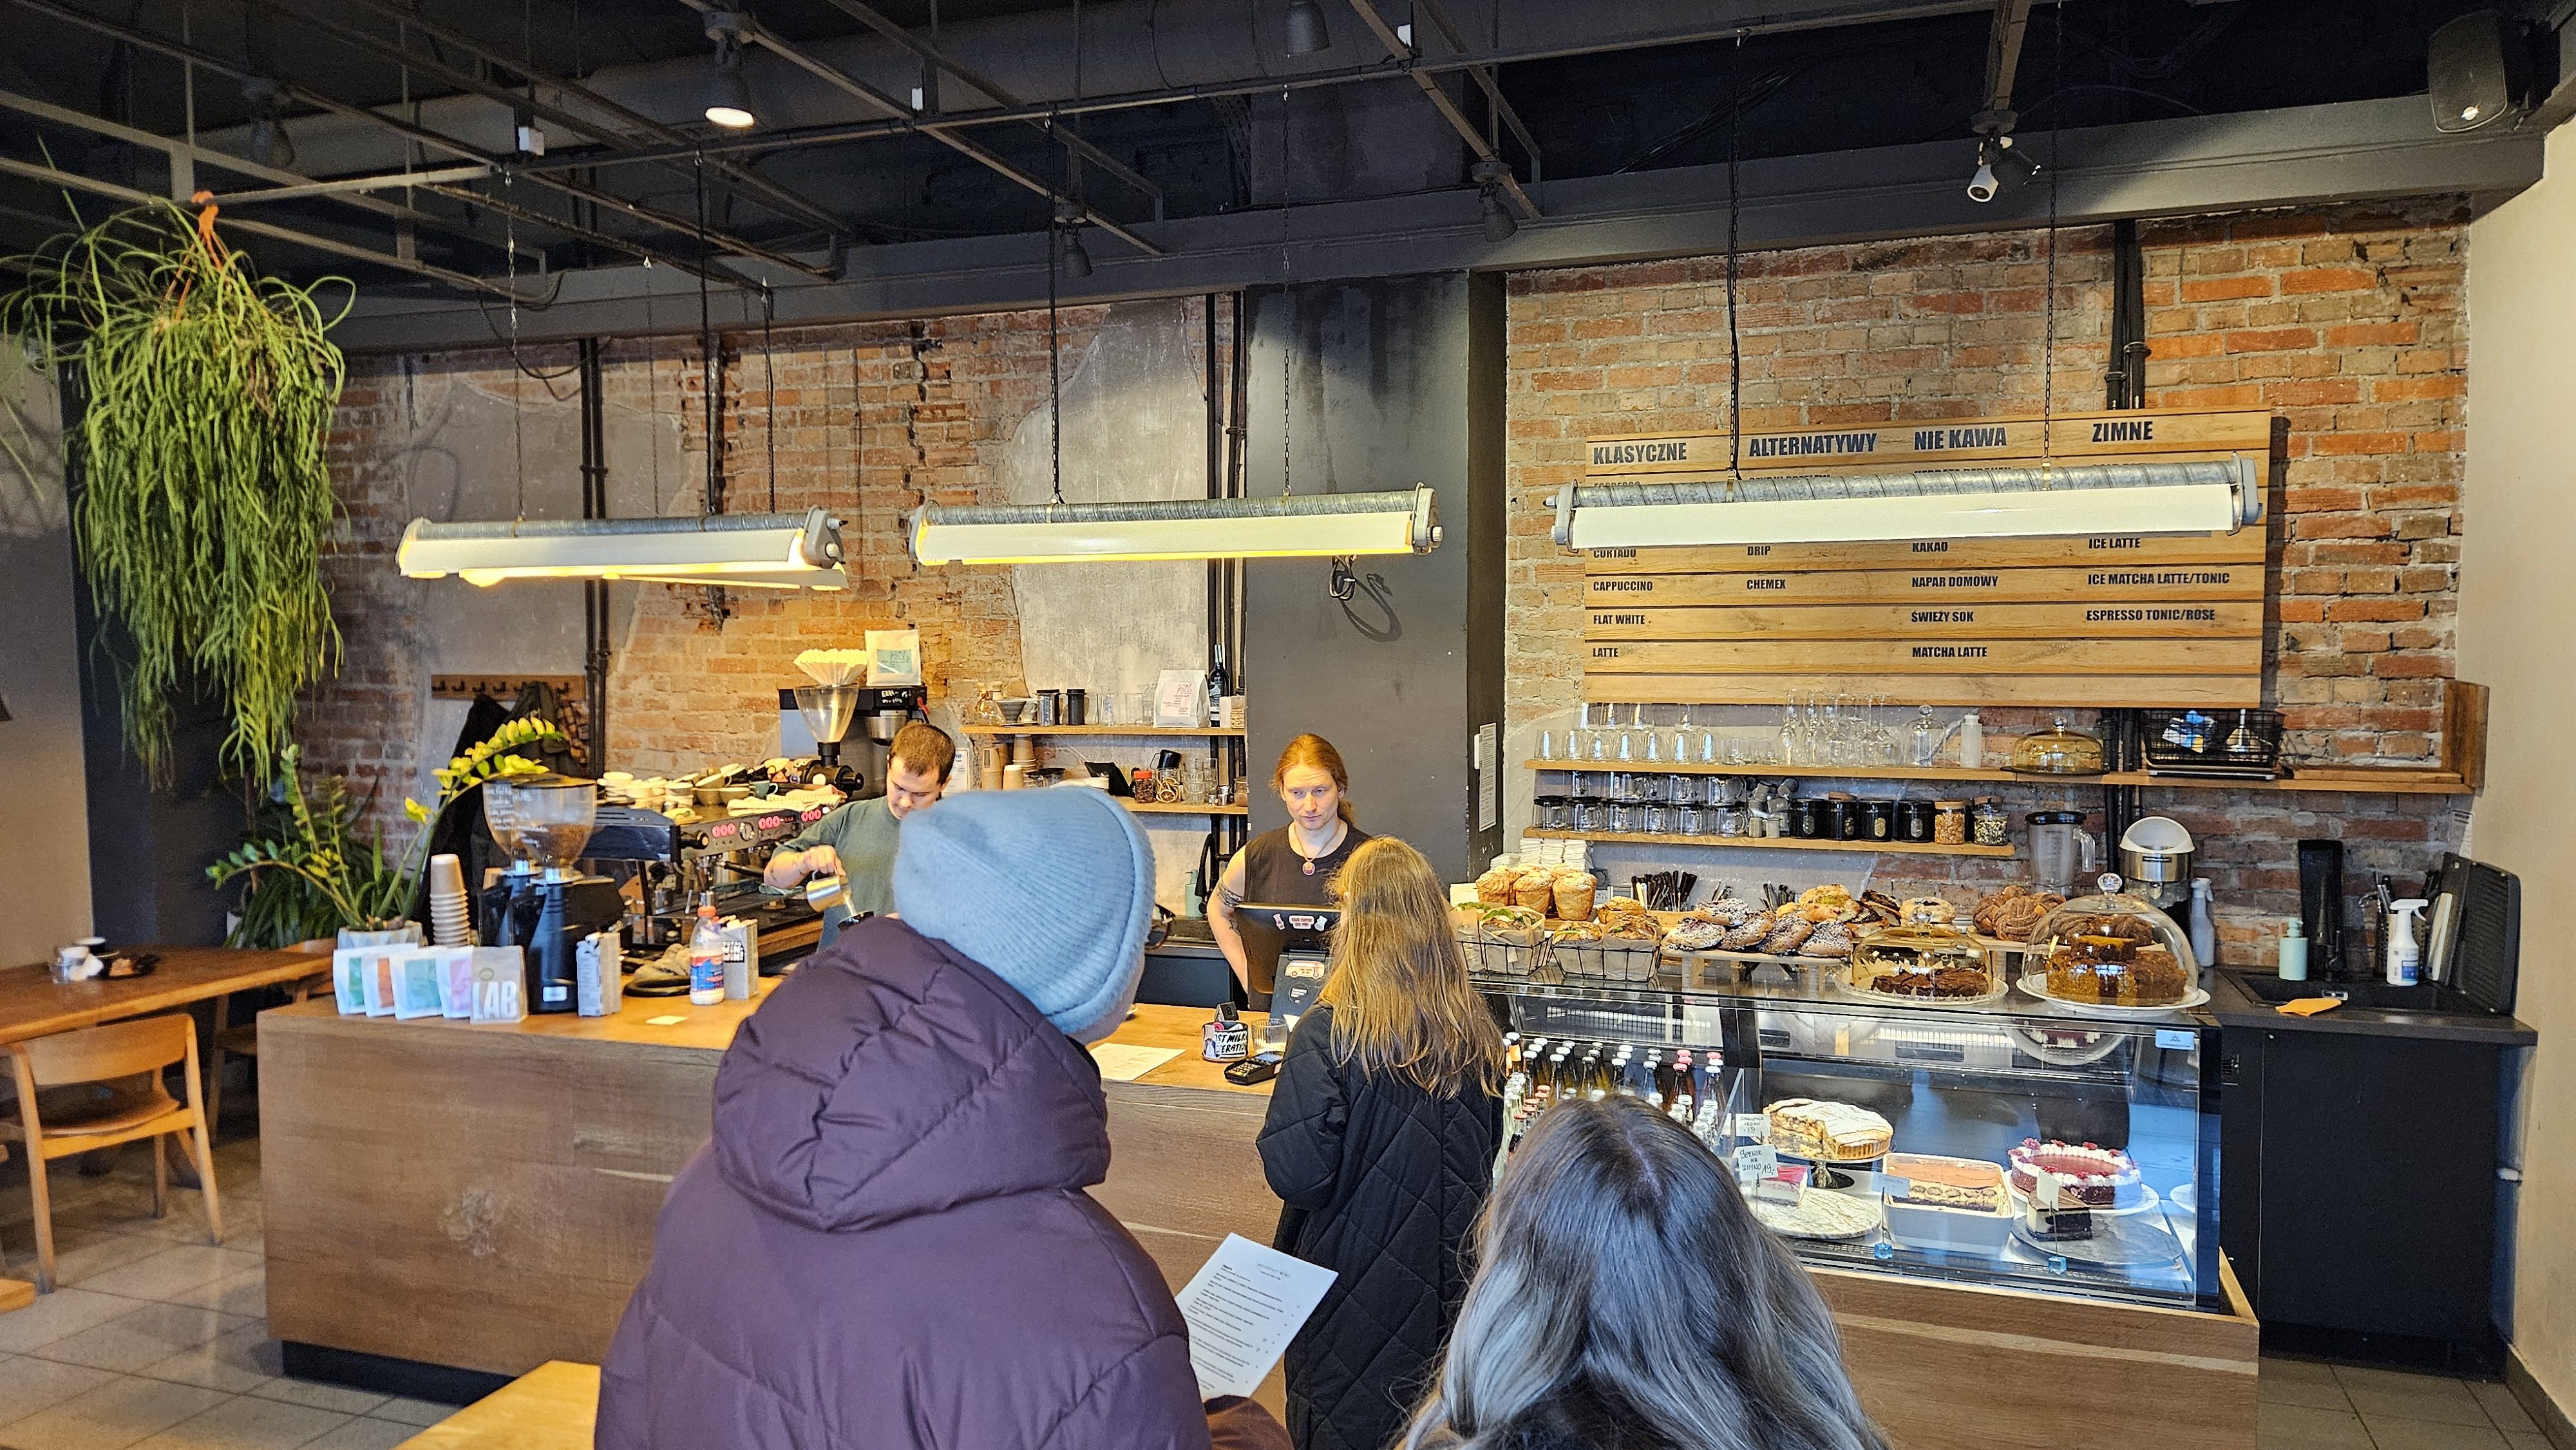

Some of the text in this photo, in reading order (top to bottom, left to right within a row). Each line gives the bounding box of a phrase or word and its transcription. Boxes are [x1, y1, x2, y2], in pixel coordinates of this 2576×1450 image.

[2092, 421, 2153, 442] ZIMNE
[1915, 428, 2007, 450] NIE KAWA
[1749, 433, 1877, 457] ALTERNATYWY
[1593, 442, 1687, 464] KLASYCZNE
[1912, 541, 1948, 552] KAKAO
[2088, 538, 2141, 549] ICE LATTE
[1747, 546, 1771, 556] DRIP
[1747, 579, 1786, 589] CHEMEX
[1912, 576, 1998, 587] NAPAR DOMOWY
[2088, 572, 2230, 585] ICE MATCHA LATTE/TONIC
[1593, 581, 1653, 591] CAPPUCCINO
[1593, 614, 1645, 625] FLAT WHITE
[1911, 610, 1974, 622] ŚWIEŻY SOK
[2087, 609, 2215, 621] ESPRESSO TONIC/ROSE
[1593, 648, 1618, 657] LATTE
[1912, 646, 1987, 657] MATCHA LATTE
[472, 980, 519, 1021] LAB
[1226, 1006, 1233, 1015] 8
